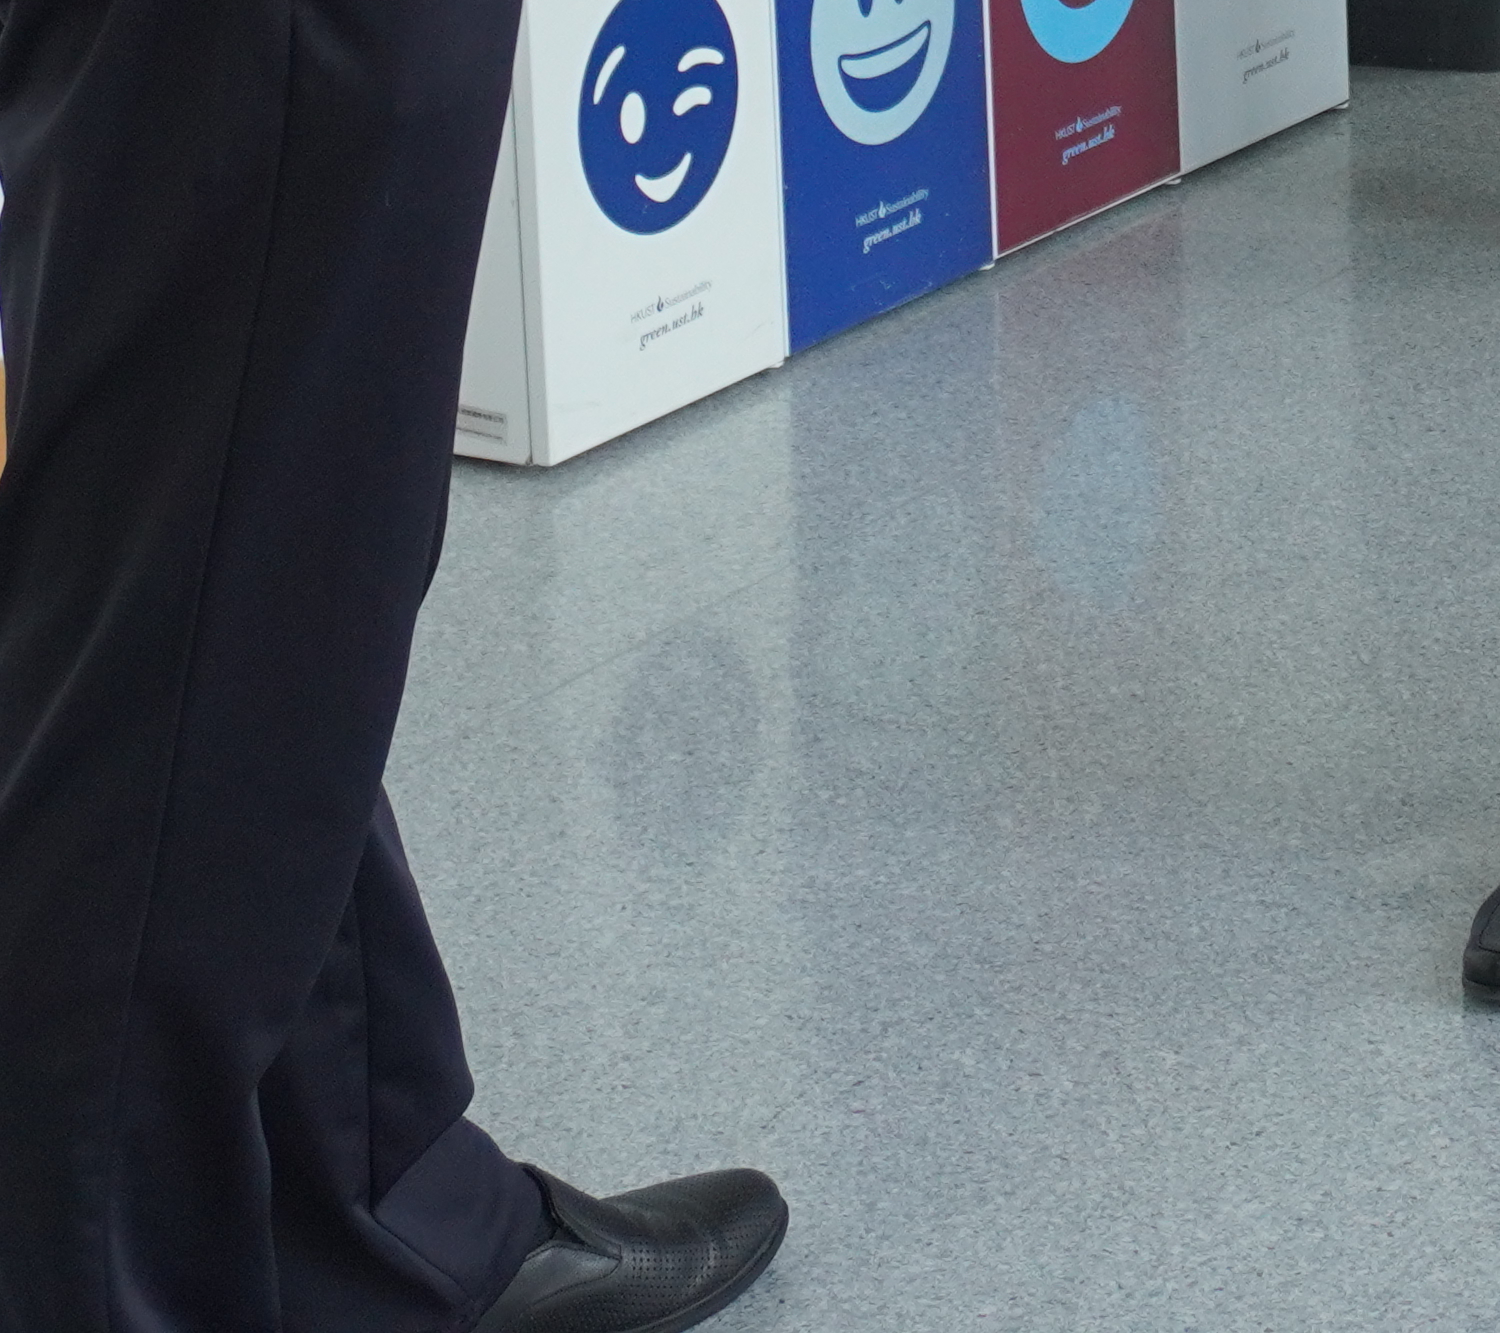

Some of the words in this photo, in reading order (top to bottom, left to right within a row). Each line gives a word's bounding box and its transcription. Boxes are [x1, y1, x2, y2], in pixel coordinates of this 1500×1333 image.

[1242, 46, 1290, 85] green.ust.hk
[1055, 122, 1076, 141] HKUST
[1061, 123, 1115, 166] green.ust.hk
[855, 208, 879, 228] HKUST
[862, 207, 922, 254] green.ust.hk
[630, 303, 656, 324] HKUST
[639, 301, 704, 352] green.ust.hk
